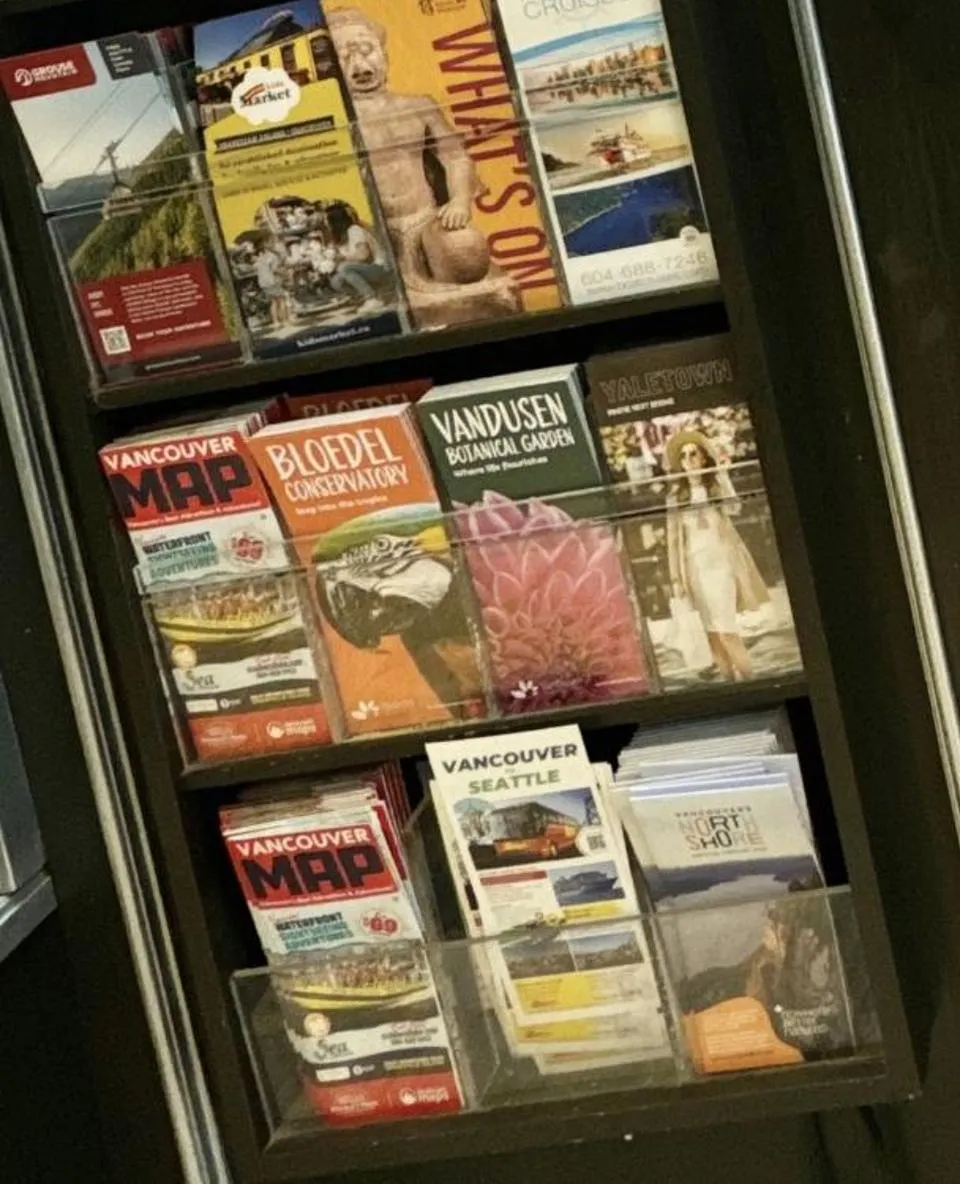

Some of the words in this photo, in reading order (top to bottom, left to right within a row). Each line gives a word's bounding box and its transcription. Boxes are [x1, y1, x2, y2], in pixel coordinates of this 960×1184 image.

[432, 20, 536, 214] WHAT'S
[486, 225, 557, 291] ON
[600, 359, 734, 403] YALETOWN
[430, 392, 569, 445] VANDUSEN
[105, 436, 237, 471] VANCOUVER
[265, 427, 402, 481] BLOEDEL
[444, 440, 518, 466] BOTANICAL
[519, 427, 576, 454] GARDEN
[109, 456, 252, 518] MAP
[283, 463, 409, 503] CONSERVATORY
[443, 743, 577, 774] VANCOUVER
[468, 769, 560, 795] SEATTLE
[236, 827, 371, 857] VANCOUVER
[241, 844, 385, 899] MAP
